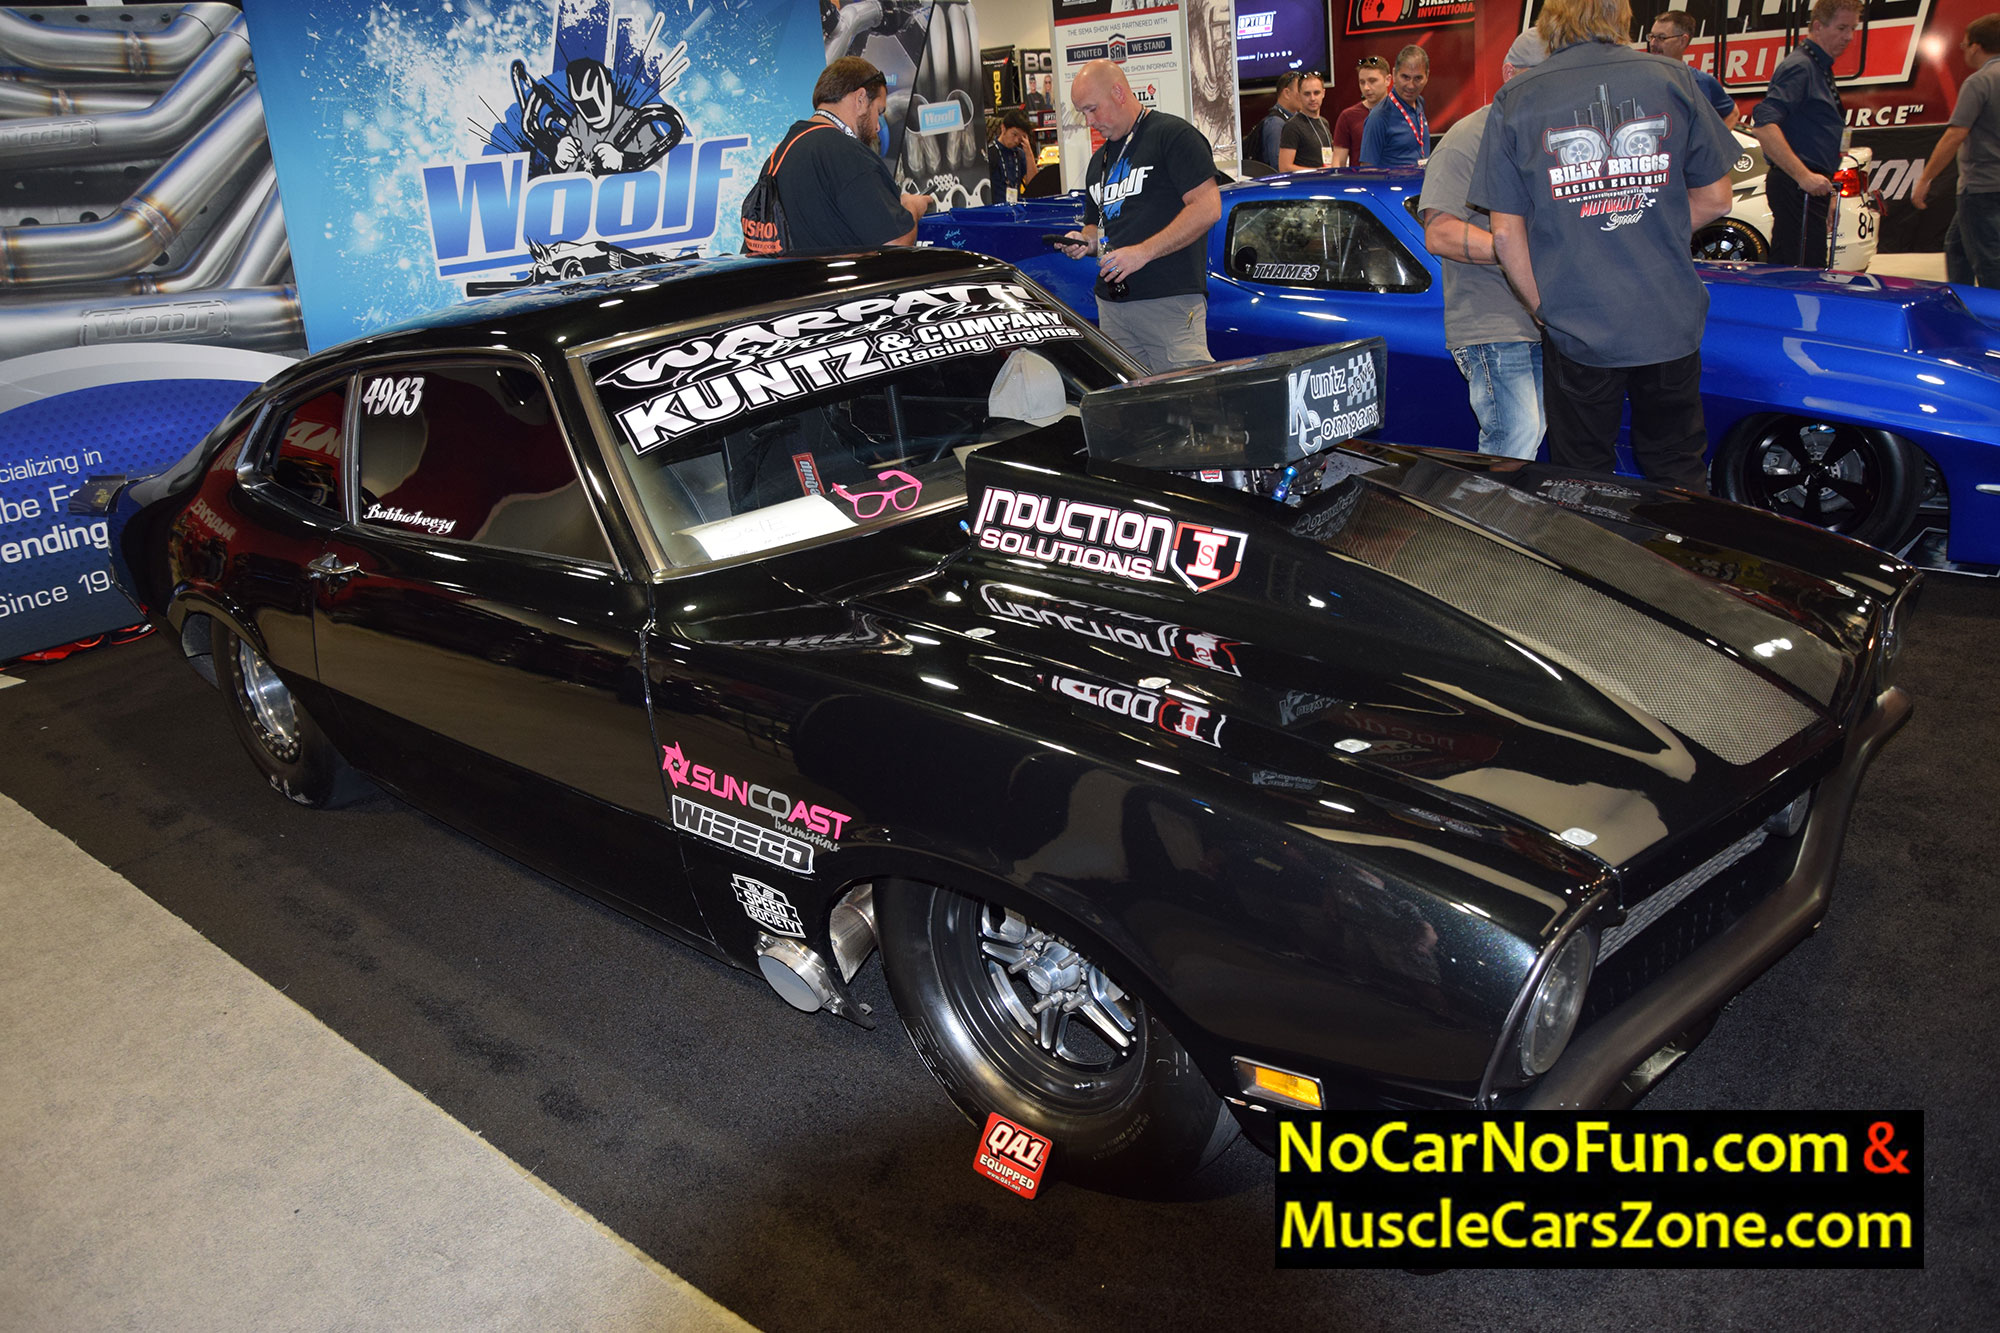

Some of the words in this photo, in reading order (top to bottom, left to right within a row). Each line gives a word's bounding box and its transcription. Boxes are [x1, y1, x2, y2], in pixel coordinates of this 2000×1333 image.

[1094, 25, 1109, 33] SHOW
[1122, 20, 1153, 29] PARTNERED
[1154, 17, 1168, 25] WITH
[1073, 48, 1103, 59] IGNITED
[1132, 43, 1143, 52] WE
[1144, 41, 1166, 51] STAND
[1146, 61, 1178, 70] INFORMATION
[1549, 161, 1602, 185] BILLY
[1607, 153, 1670, 175] BRIGGS
[423, 136, 749, 261] Woolf
[1554, 181, 1605, 198] RACING
[1858, 211, 1874, 240] 84
[1252, 263, 1320, 280] THAMES
[612, 283, 1033, 385] WARPATH
[889, 337, 990, 367] Racing
[993, 326, 1081, 345] Engines
[362, 377, 426, 416] 4983
[621, 336, 889, 453] KUNTZ
[878, 332, 915, 353] &
[915, 311, 1064, 345] COMPANY
[1288, 367, 1347, 436] Kuntz
[1332, 399, 1340, 412] &
[1299, 402, 1380, 457] Company
[83, 448, 103, 466] in
[974, 486, 1175, 573] INDUCTION
[979, 527, 1155, 582] SOLUTIONS
[690, 763, 852, 840] SUNCOAST
[743, 890, 789, 919] SPEED
[748, 905, 797, 933] SOCIETY
[987, 1122, 1044, 1170] QA1
[979, 1153, 1036, 1191] EQUIPPED
[986, 1170, 1022, 1193] www.QA1.net
